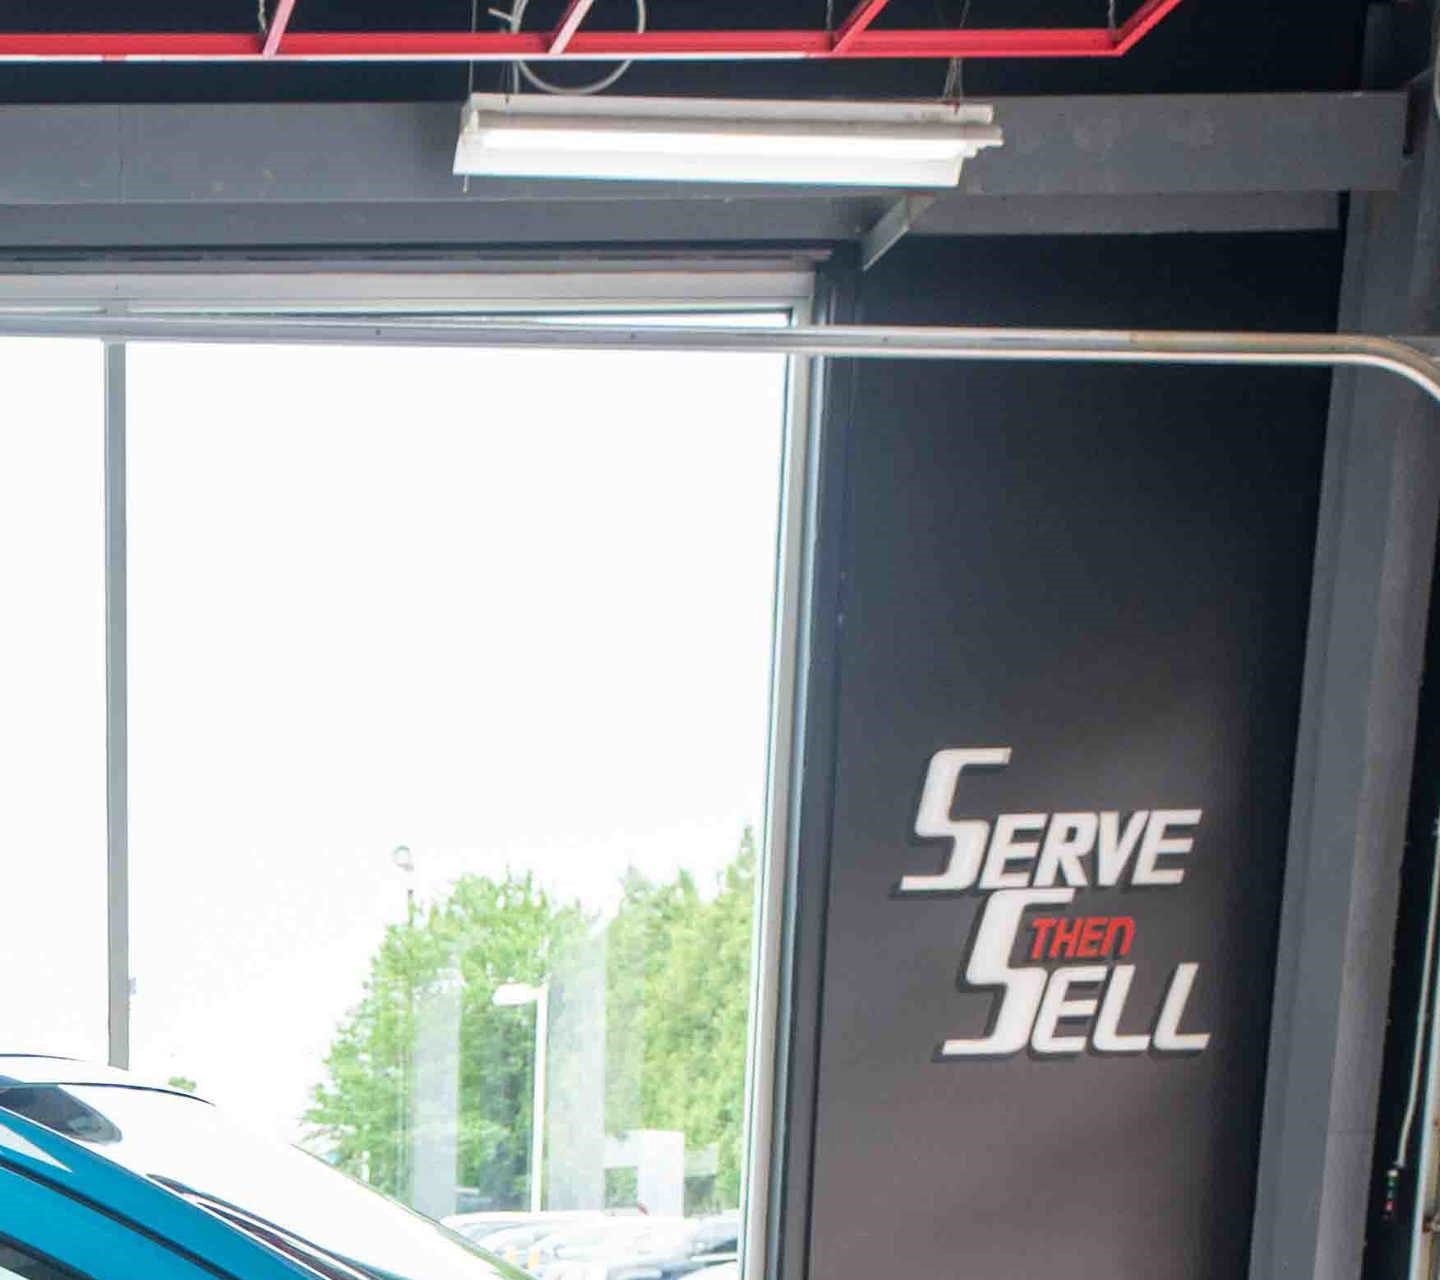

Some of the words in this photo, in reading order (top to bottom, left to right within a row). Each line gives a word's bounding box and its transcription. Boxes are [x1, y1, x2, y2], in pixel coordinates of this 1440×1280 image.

[900, 747, 1202, 891] SERVE
[942, 887, 1212, 1056] SELL
[1029, 916, 1136, 961] THEN
